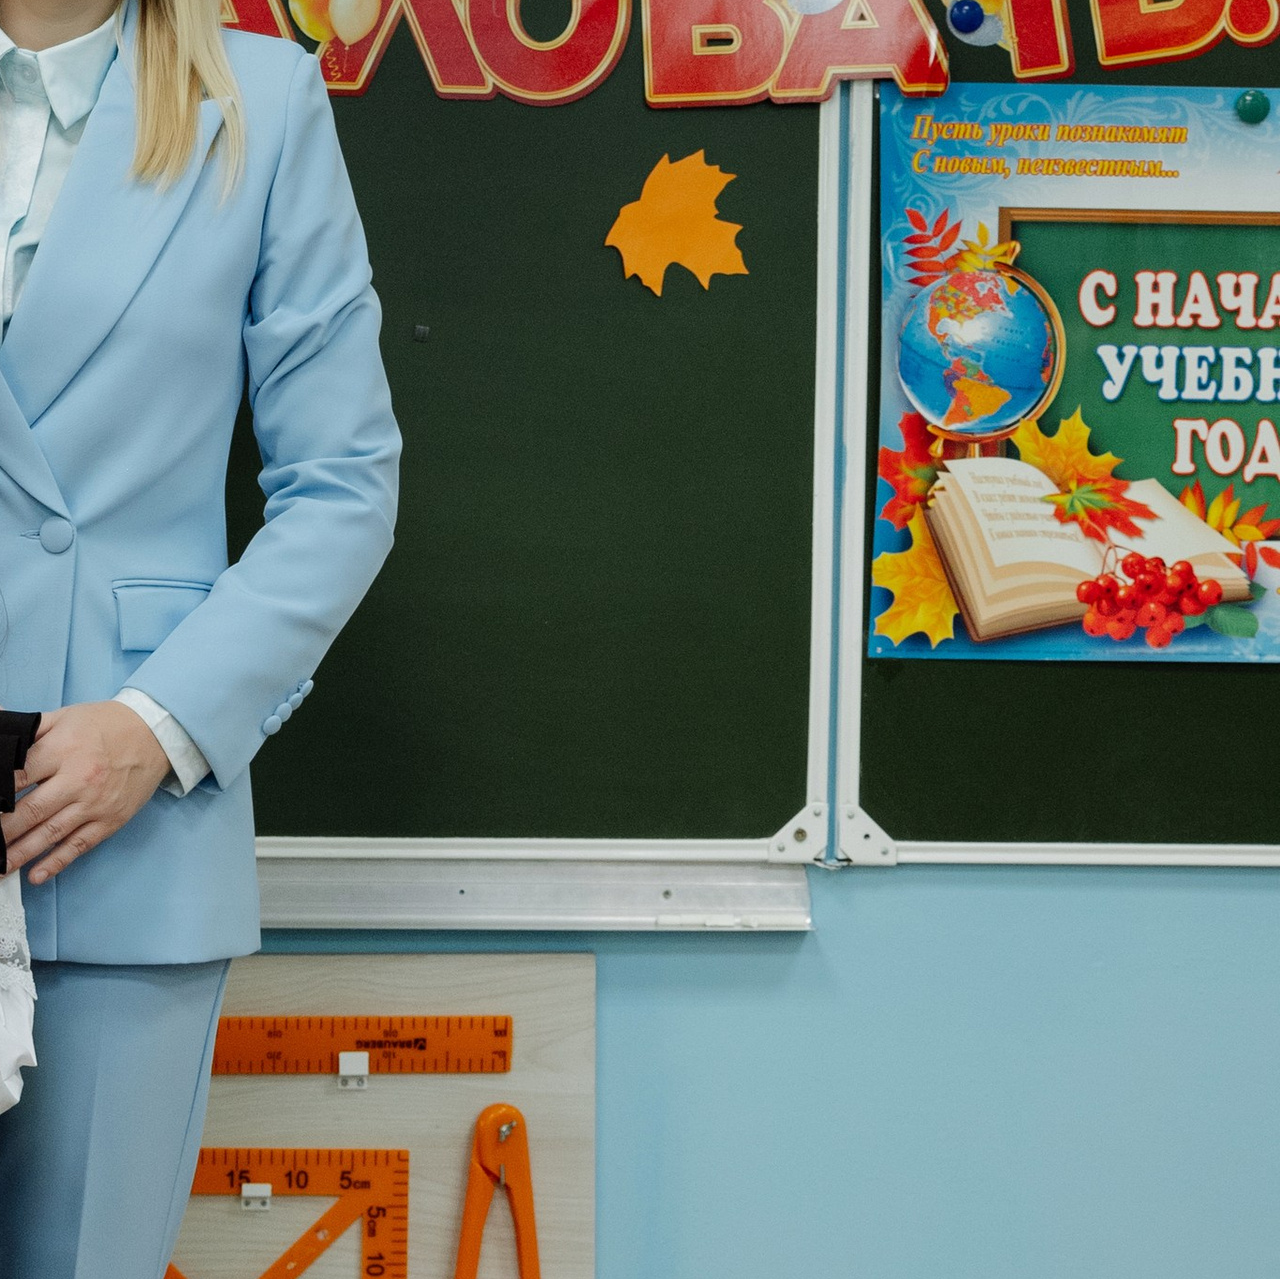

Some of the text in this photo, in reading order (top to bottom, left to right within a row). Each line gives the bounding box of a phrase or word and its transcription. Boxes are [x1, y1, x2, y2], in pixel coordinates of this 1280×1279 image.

[911, 114, 1188, 147] Пусть уроки познакомят
[912, 148, 1180, 179] С новым, неизвестным...
[1078, 269, 1118, 327] С
[1170, 417, 1280, 484] ГОД
[355, 1038, 415, 1050] BRAUBERG
[226, 1170, 371, 1190] 15 10 5cm
[366, 1252, 385, 1277] 10
